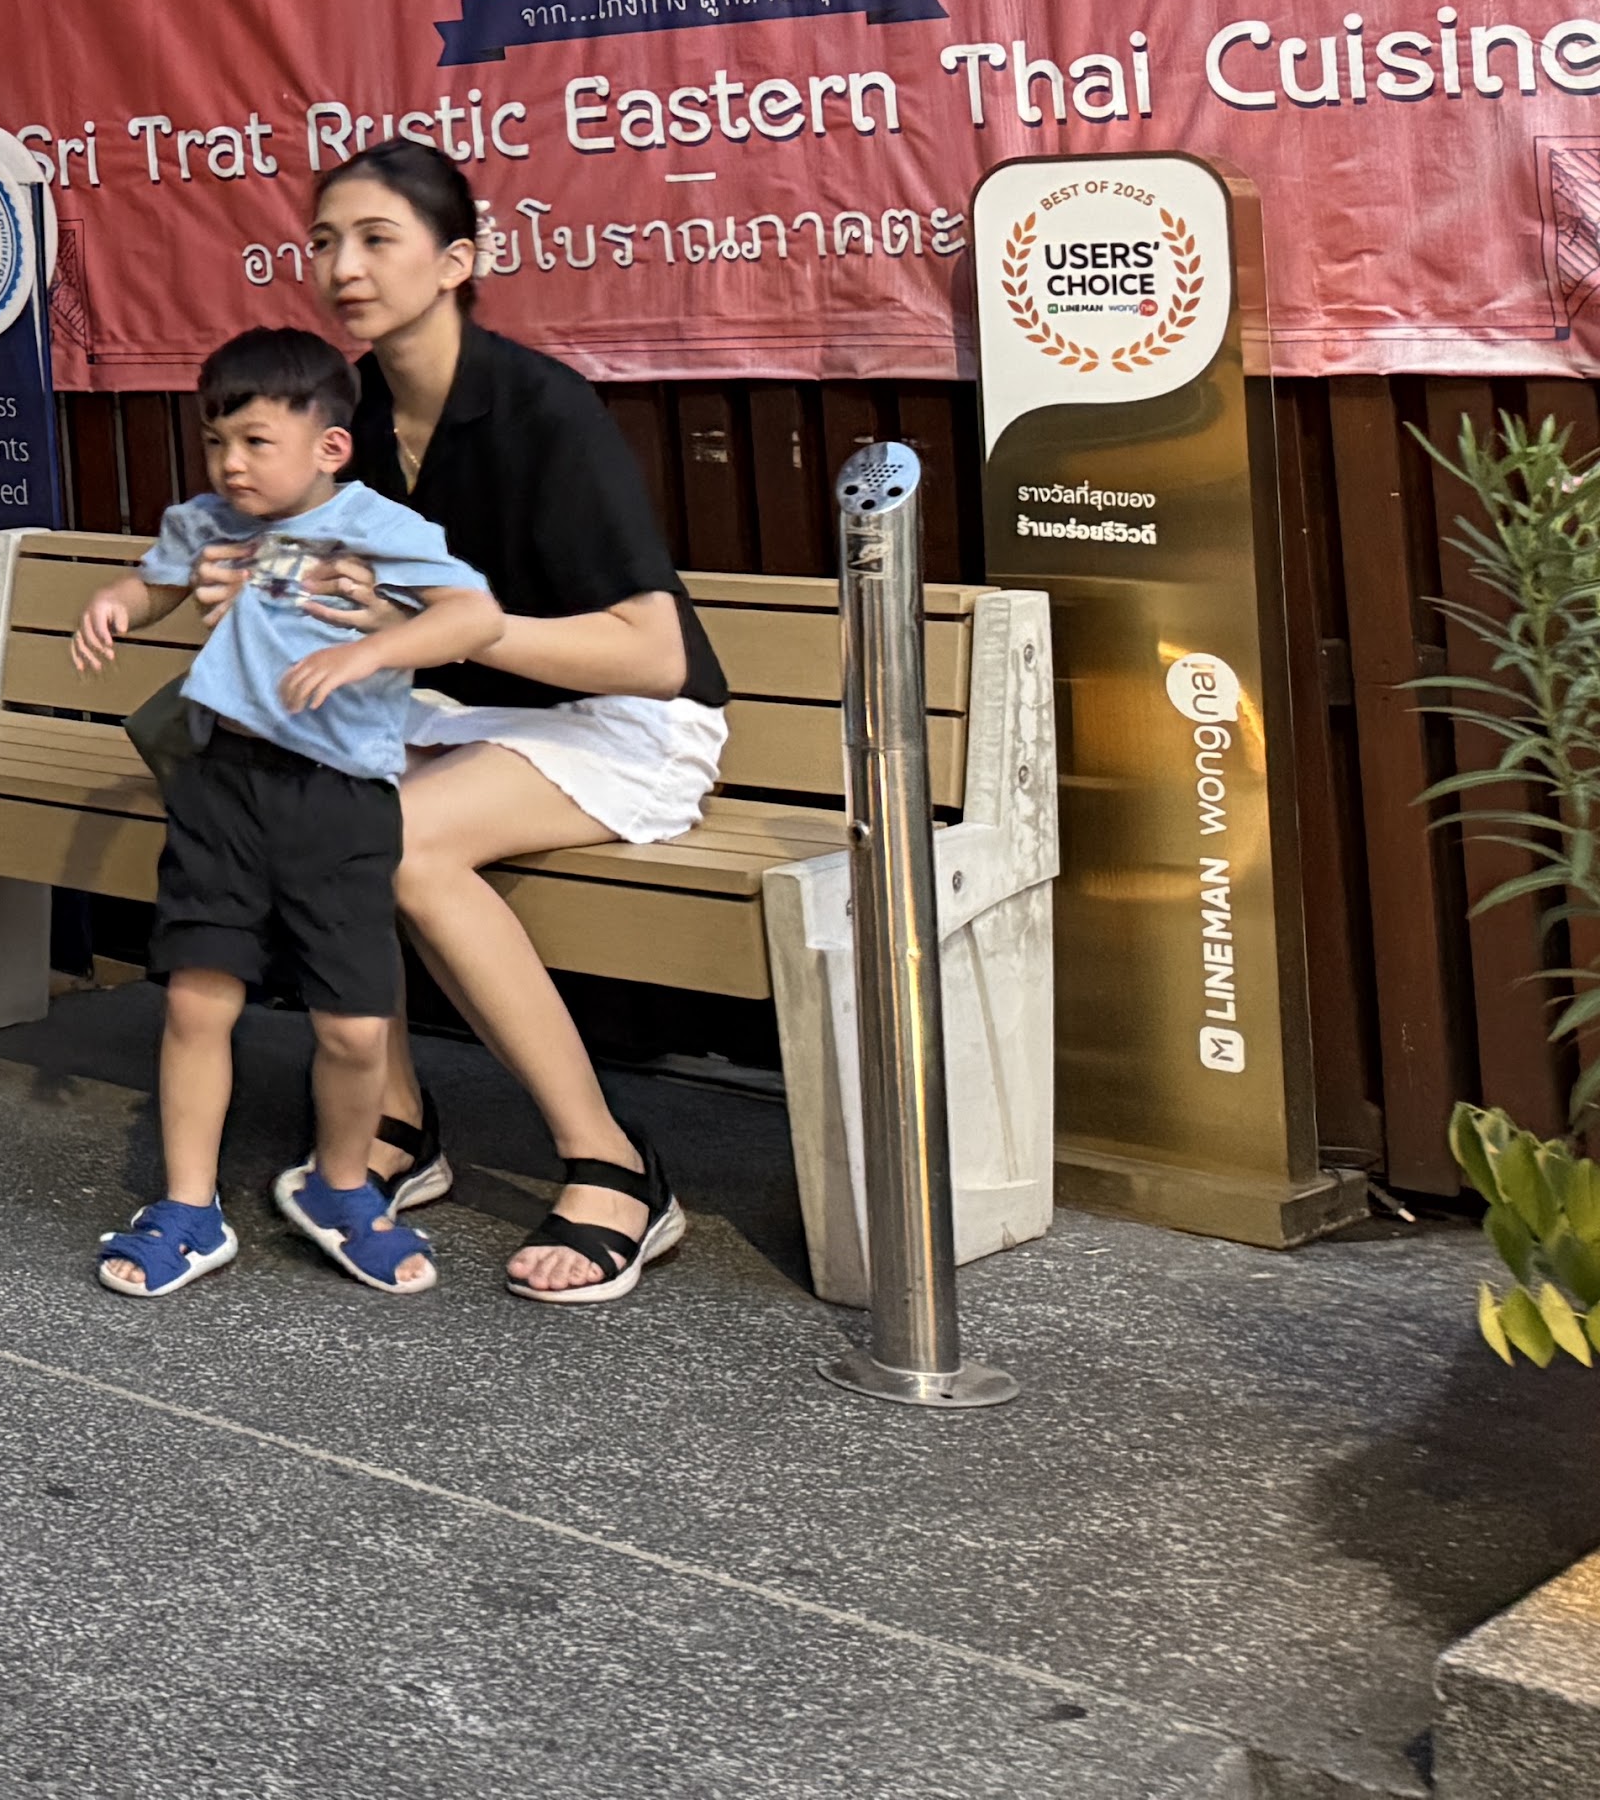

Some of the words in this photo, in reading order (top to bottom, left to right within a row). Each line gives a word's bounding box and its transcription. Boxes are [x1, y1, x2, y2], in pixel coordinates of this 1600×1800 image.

[15, 120, 100, 188] Sri
[128, 112, 279, 183] Trat
[306, 89, 528, 172] Rustic
[564, 68, 901, 152] Eastern
[940, 30, 1154, 128] Thai
[1205, 5, 1600, 110] Cuisine
[1040, 183, 1079, 211] BEST
[1084, 180, 1109, 194] OF
[1113, 182, 1156, 206] 2025
[1047, 273, 1155, 296] CHOICE
[1017, 479, 1156, 511] รางวัลที่สุดของ
[1016, 513, 1158, 545] ร้านอร่อยรีวิวดี
[1181, 661, 1232, 837] wongnai
